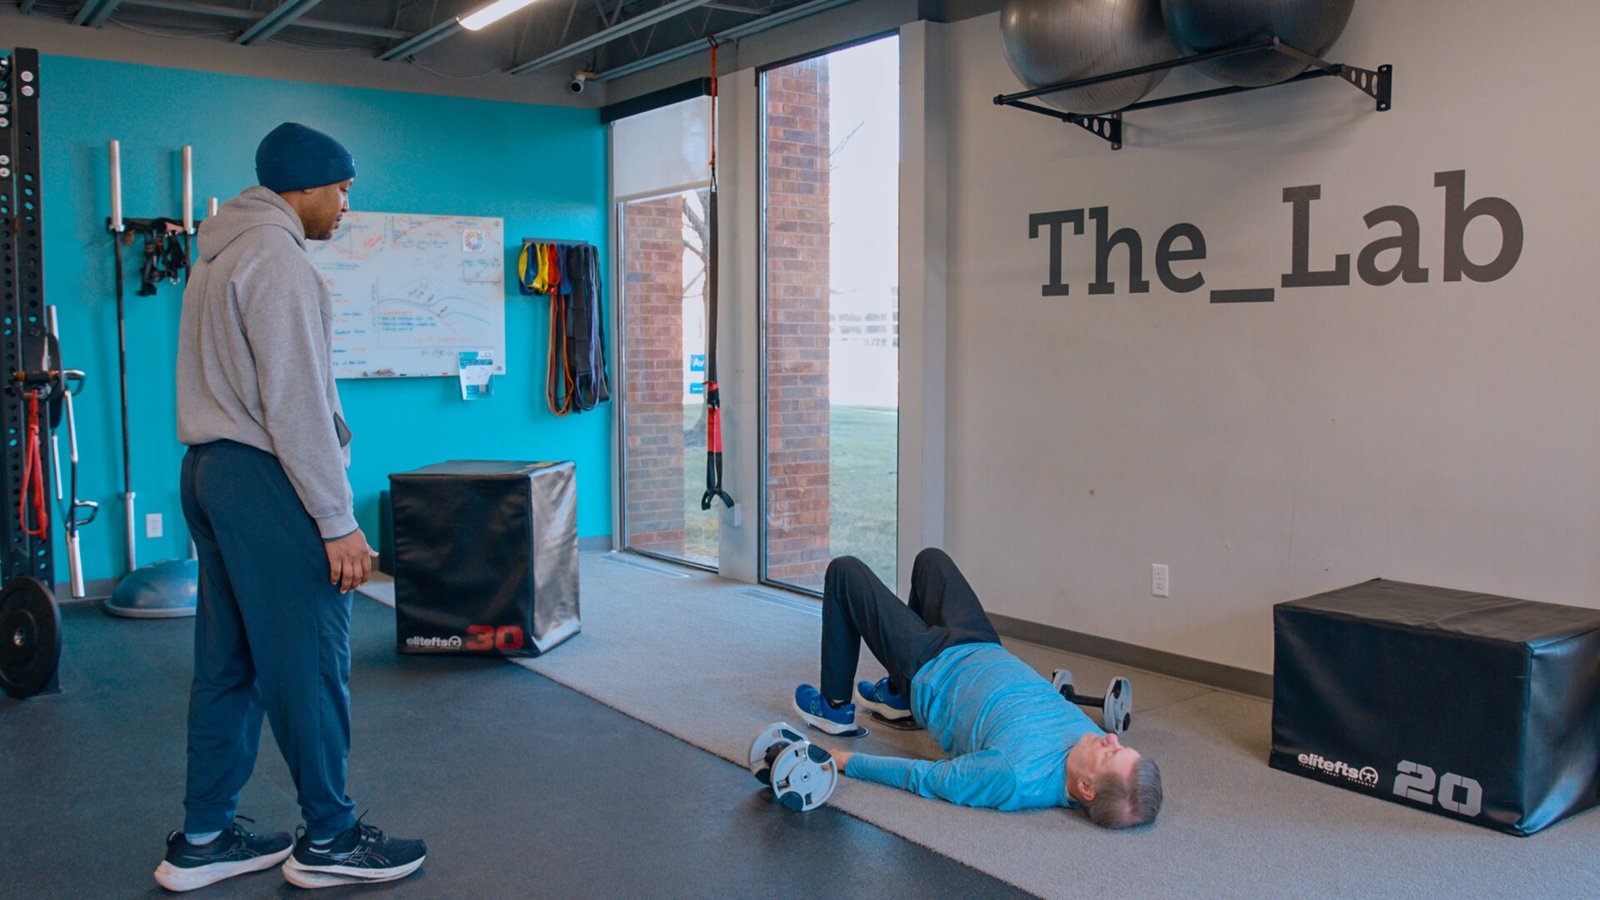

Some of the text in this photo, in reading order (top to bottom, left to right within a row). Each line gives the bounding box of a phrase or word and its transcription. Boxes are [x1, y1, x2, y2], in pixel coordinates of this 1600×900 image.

[465, 625, 523, 651] 30
[1297, 753, 1359, 778] elitefts
[1392, 759, 1483, 818] 20
